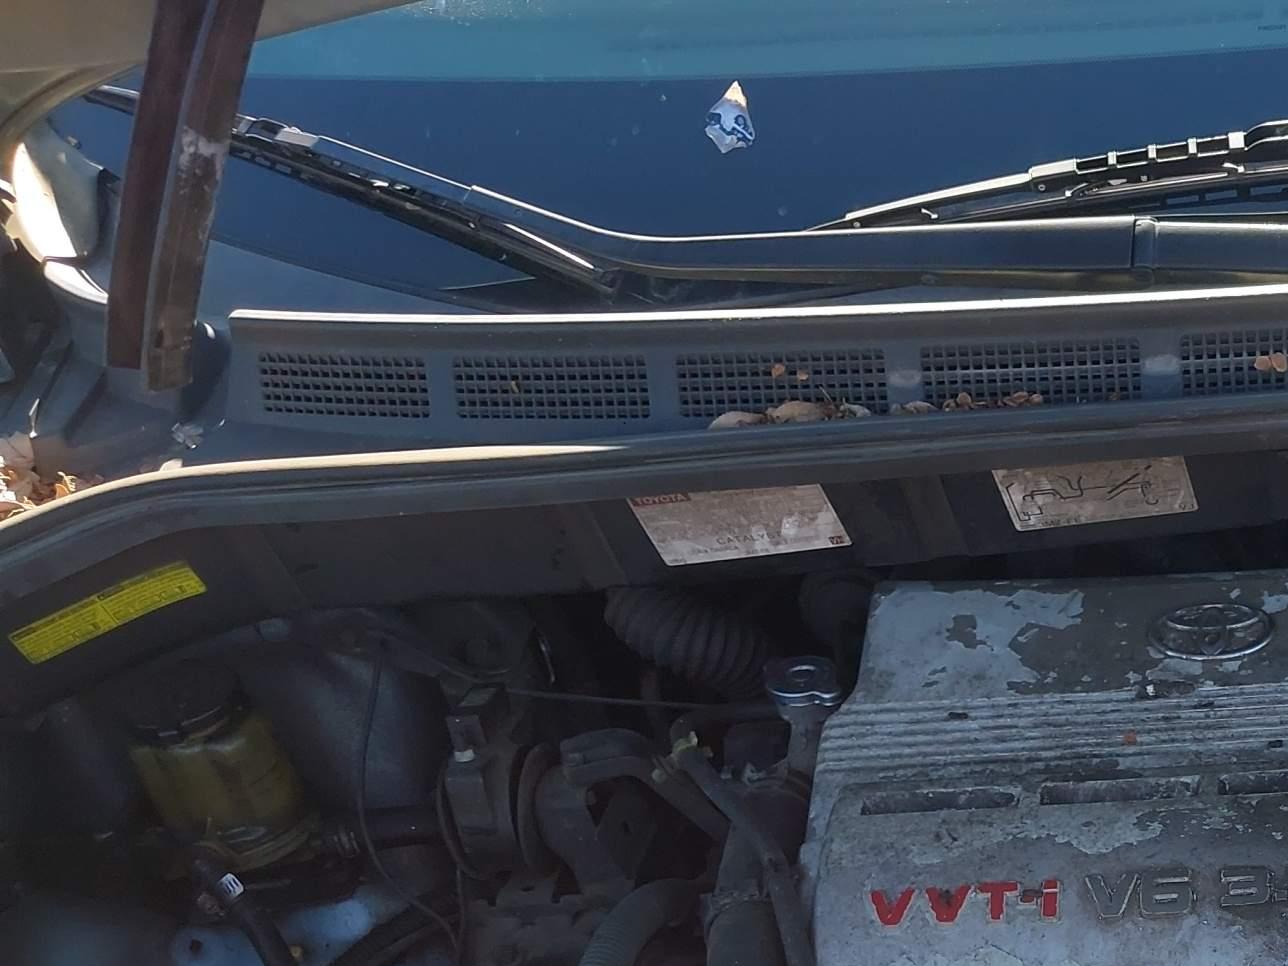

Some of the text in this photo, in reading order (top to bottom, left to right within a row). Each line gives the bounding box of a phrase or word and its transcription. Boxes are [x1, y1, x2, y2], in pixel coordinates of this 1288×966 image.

[634, 493, 689, 506] TOYOTA
[869, 879, 1064, 926] VVT-i
[1083, 868, 1197, 921] V6
